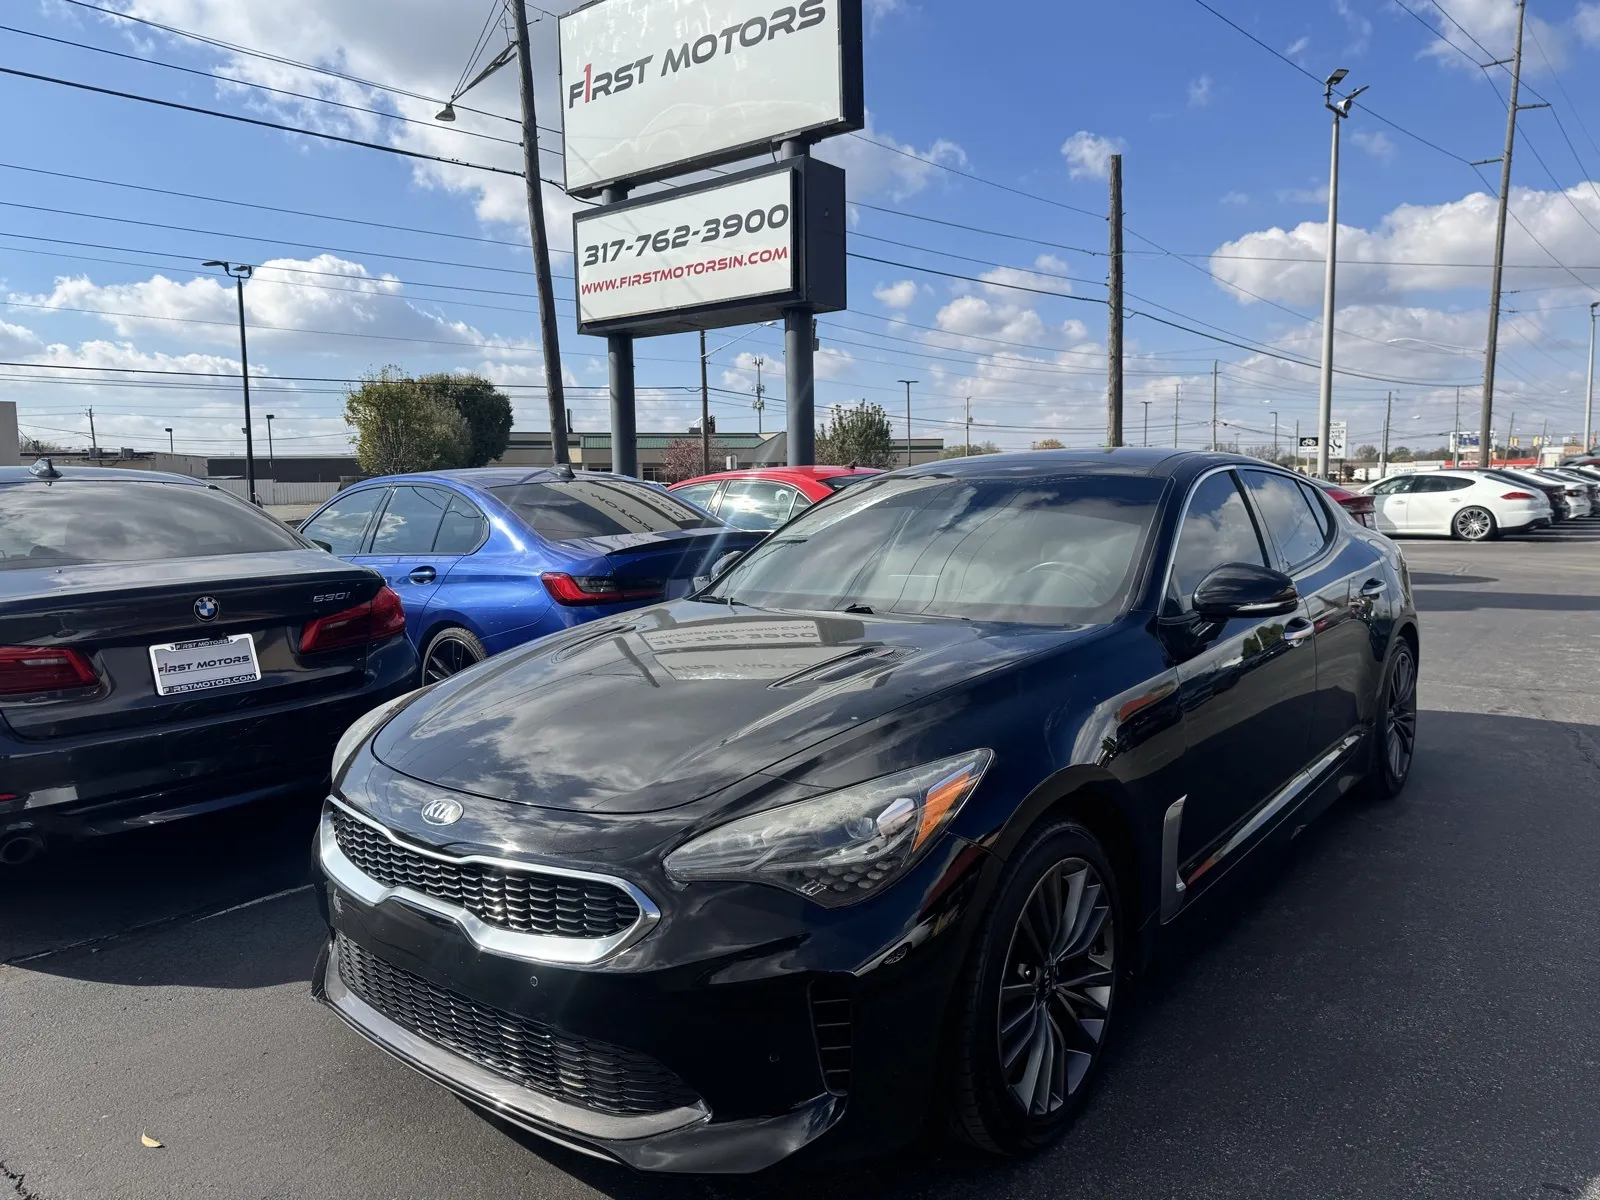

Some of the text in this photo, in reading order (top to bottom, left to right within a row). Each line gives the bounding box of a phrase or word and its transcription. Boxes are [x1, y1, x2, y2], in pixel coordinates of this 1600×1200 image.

[660, 0, 826, 77] MOTORS
[583, 204, 789, 267] 317-762-3900
[581, 246, 788, 295] WWW.FIRSTMOTORSIN.COM
[197, 639, 229, 647] MOTORS
[197, 655, 250, 669] MOTORS
[425, 802, 454, 821] KIA
